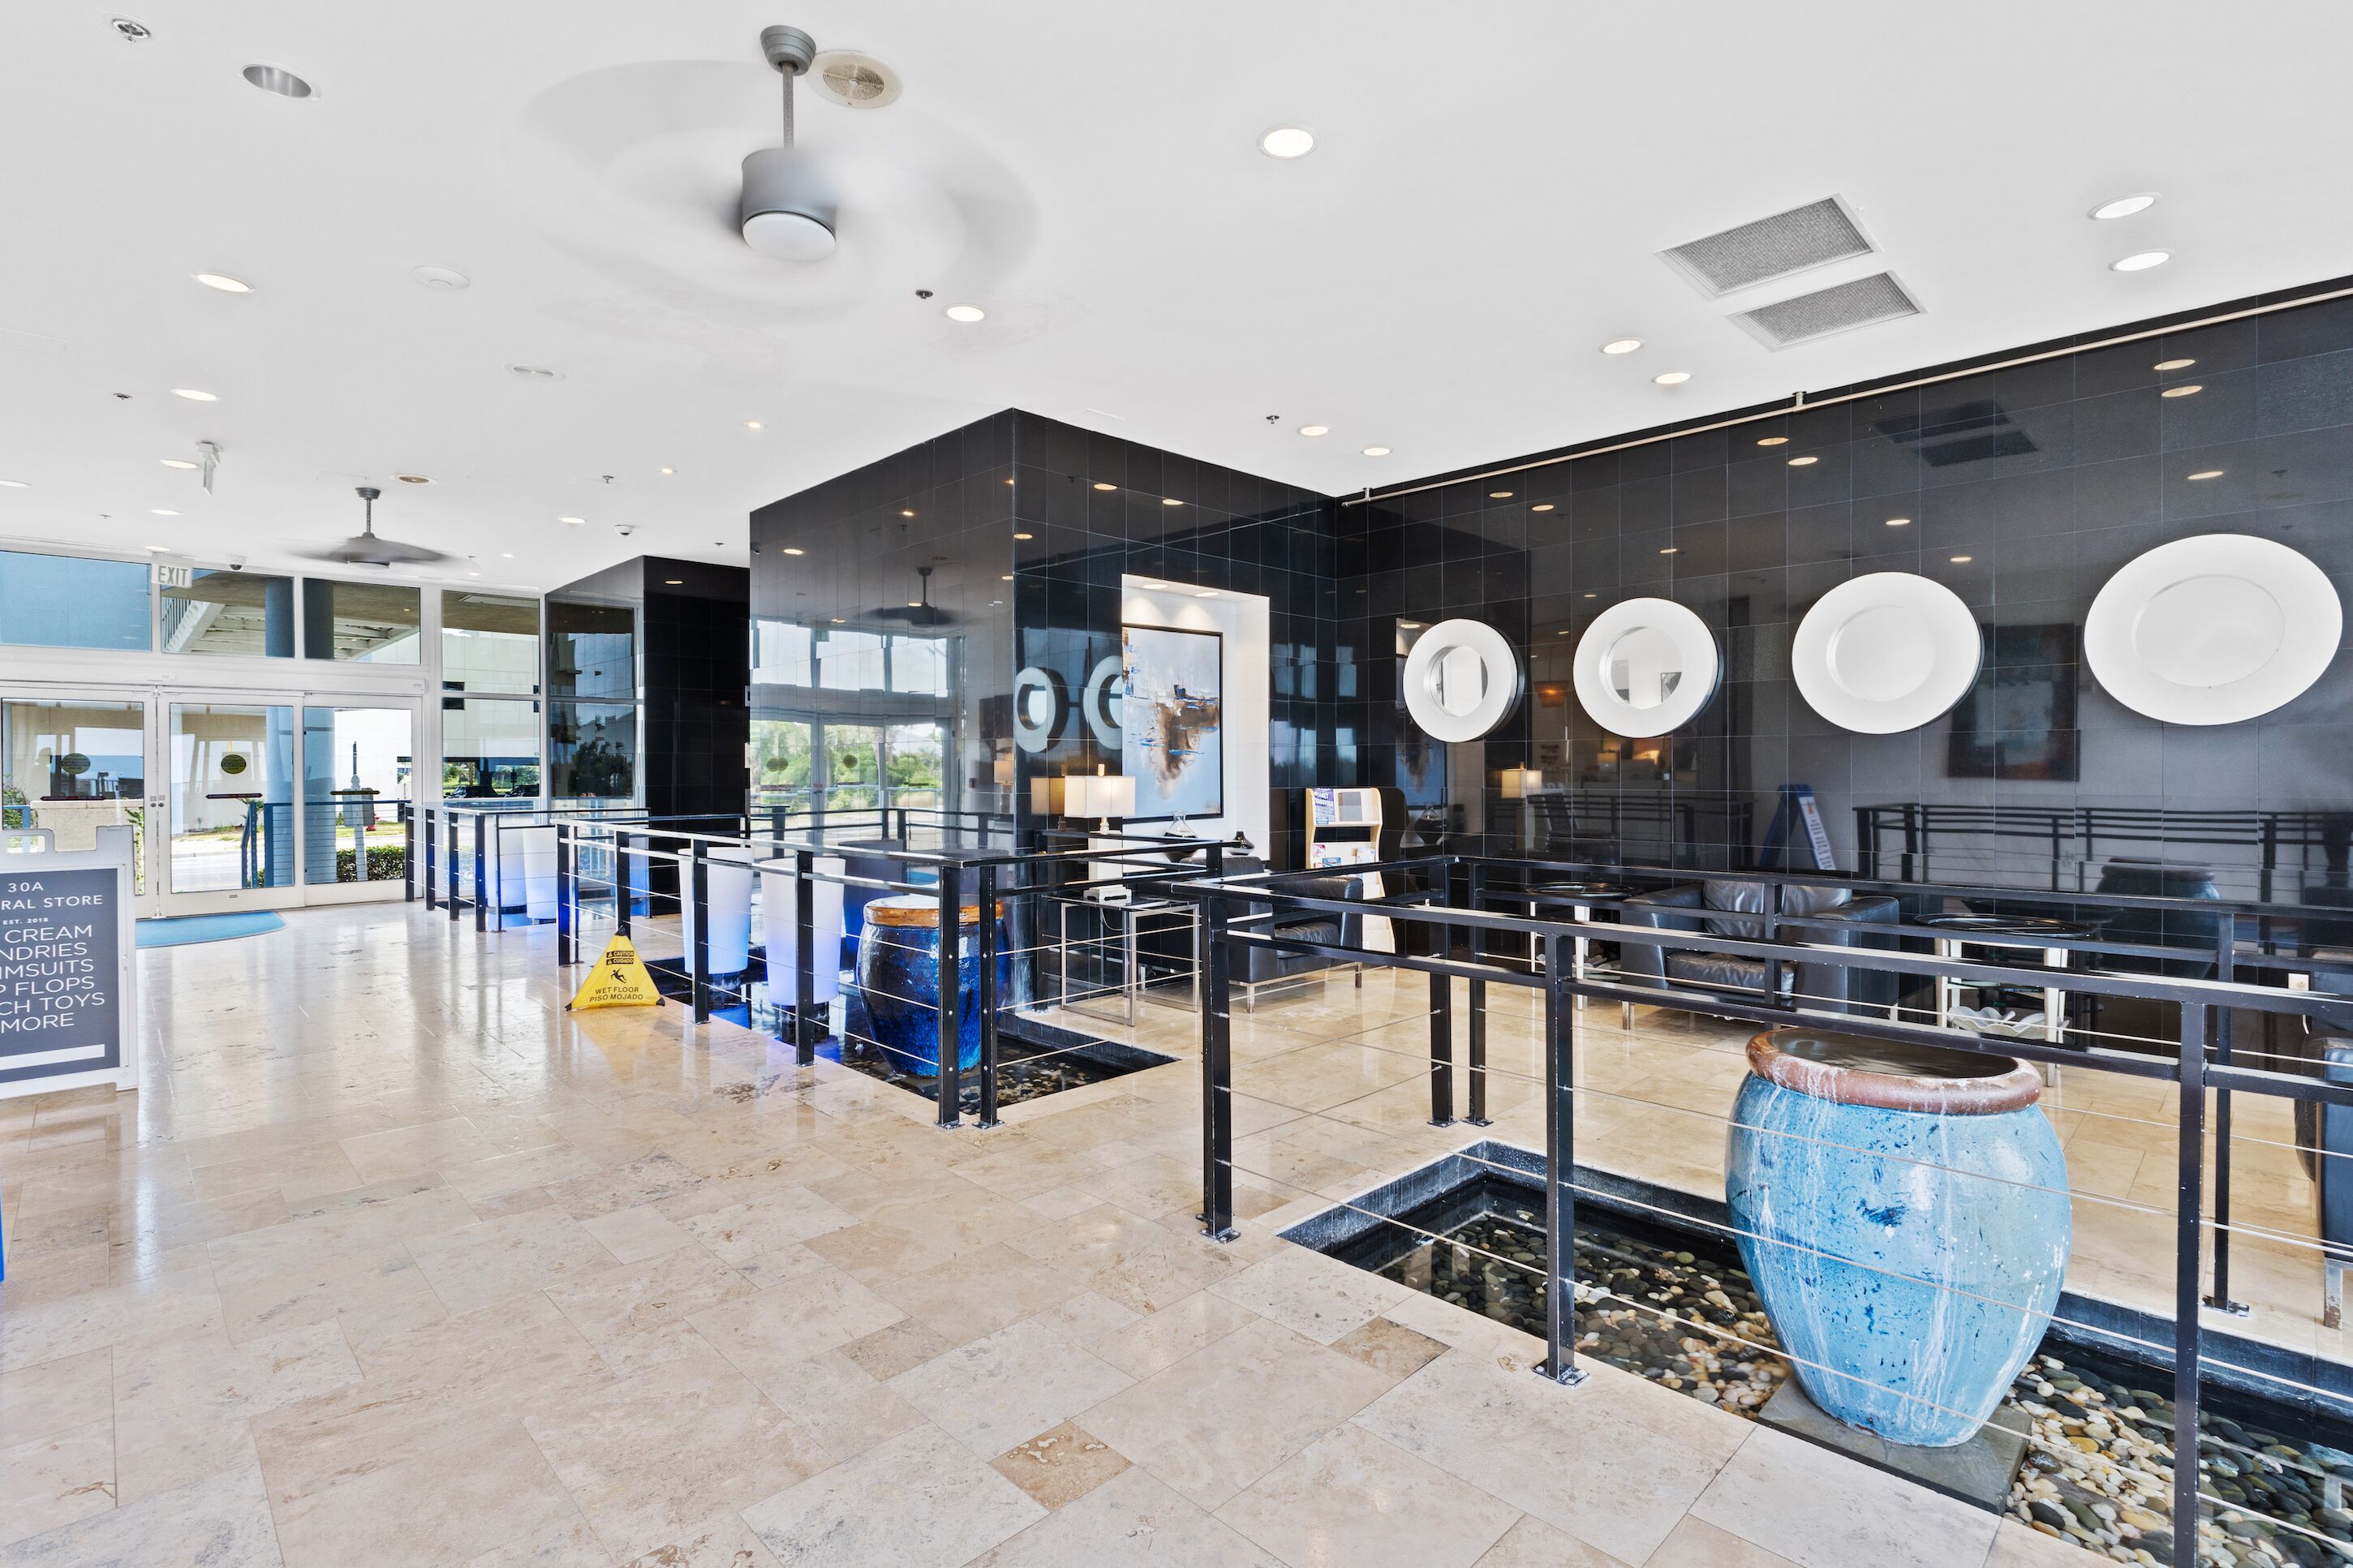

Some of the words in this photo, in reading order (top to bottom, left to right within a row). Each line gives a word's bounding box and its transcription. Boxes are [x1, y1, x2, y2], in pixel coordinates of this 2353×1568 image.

[158, 565, 188, 586] EXIT
[7, 882, 44, 892] 30A
[1, 899, 36, 910] RAL
[43, 895, 103, 908] STORE
[4, 925, 92, 943] CREAM
[0, 942, 88, 961] NDRIES
[15, 976, 95, 996] FLOPS
[0, 999, 30, 1016] CH
[39, 992, 105, 1011] TOYS
[589, 994, 609, 1003] PISO
[1, 1012, 75, 1034] MORE
